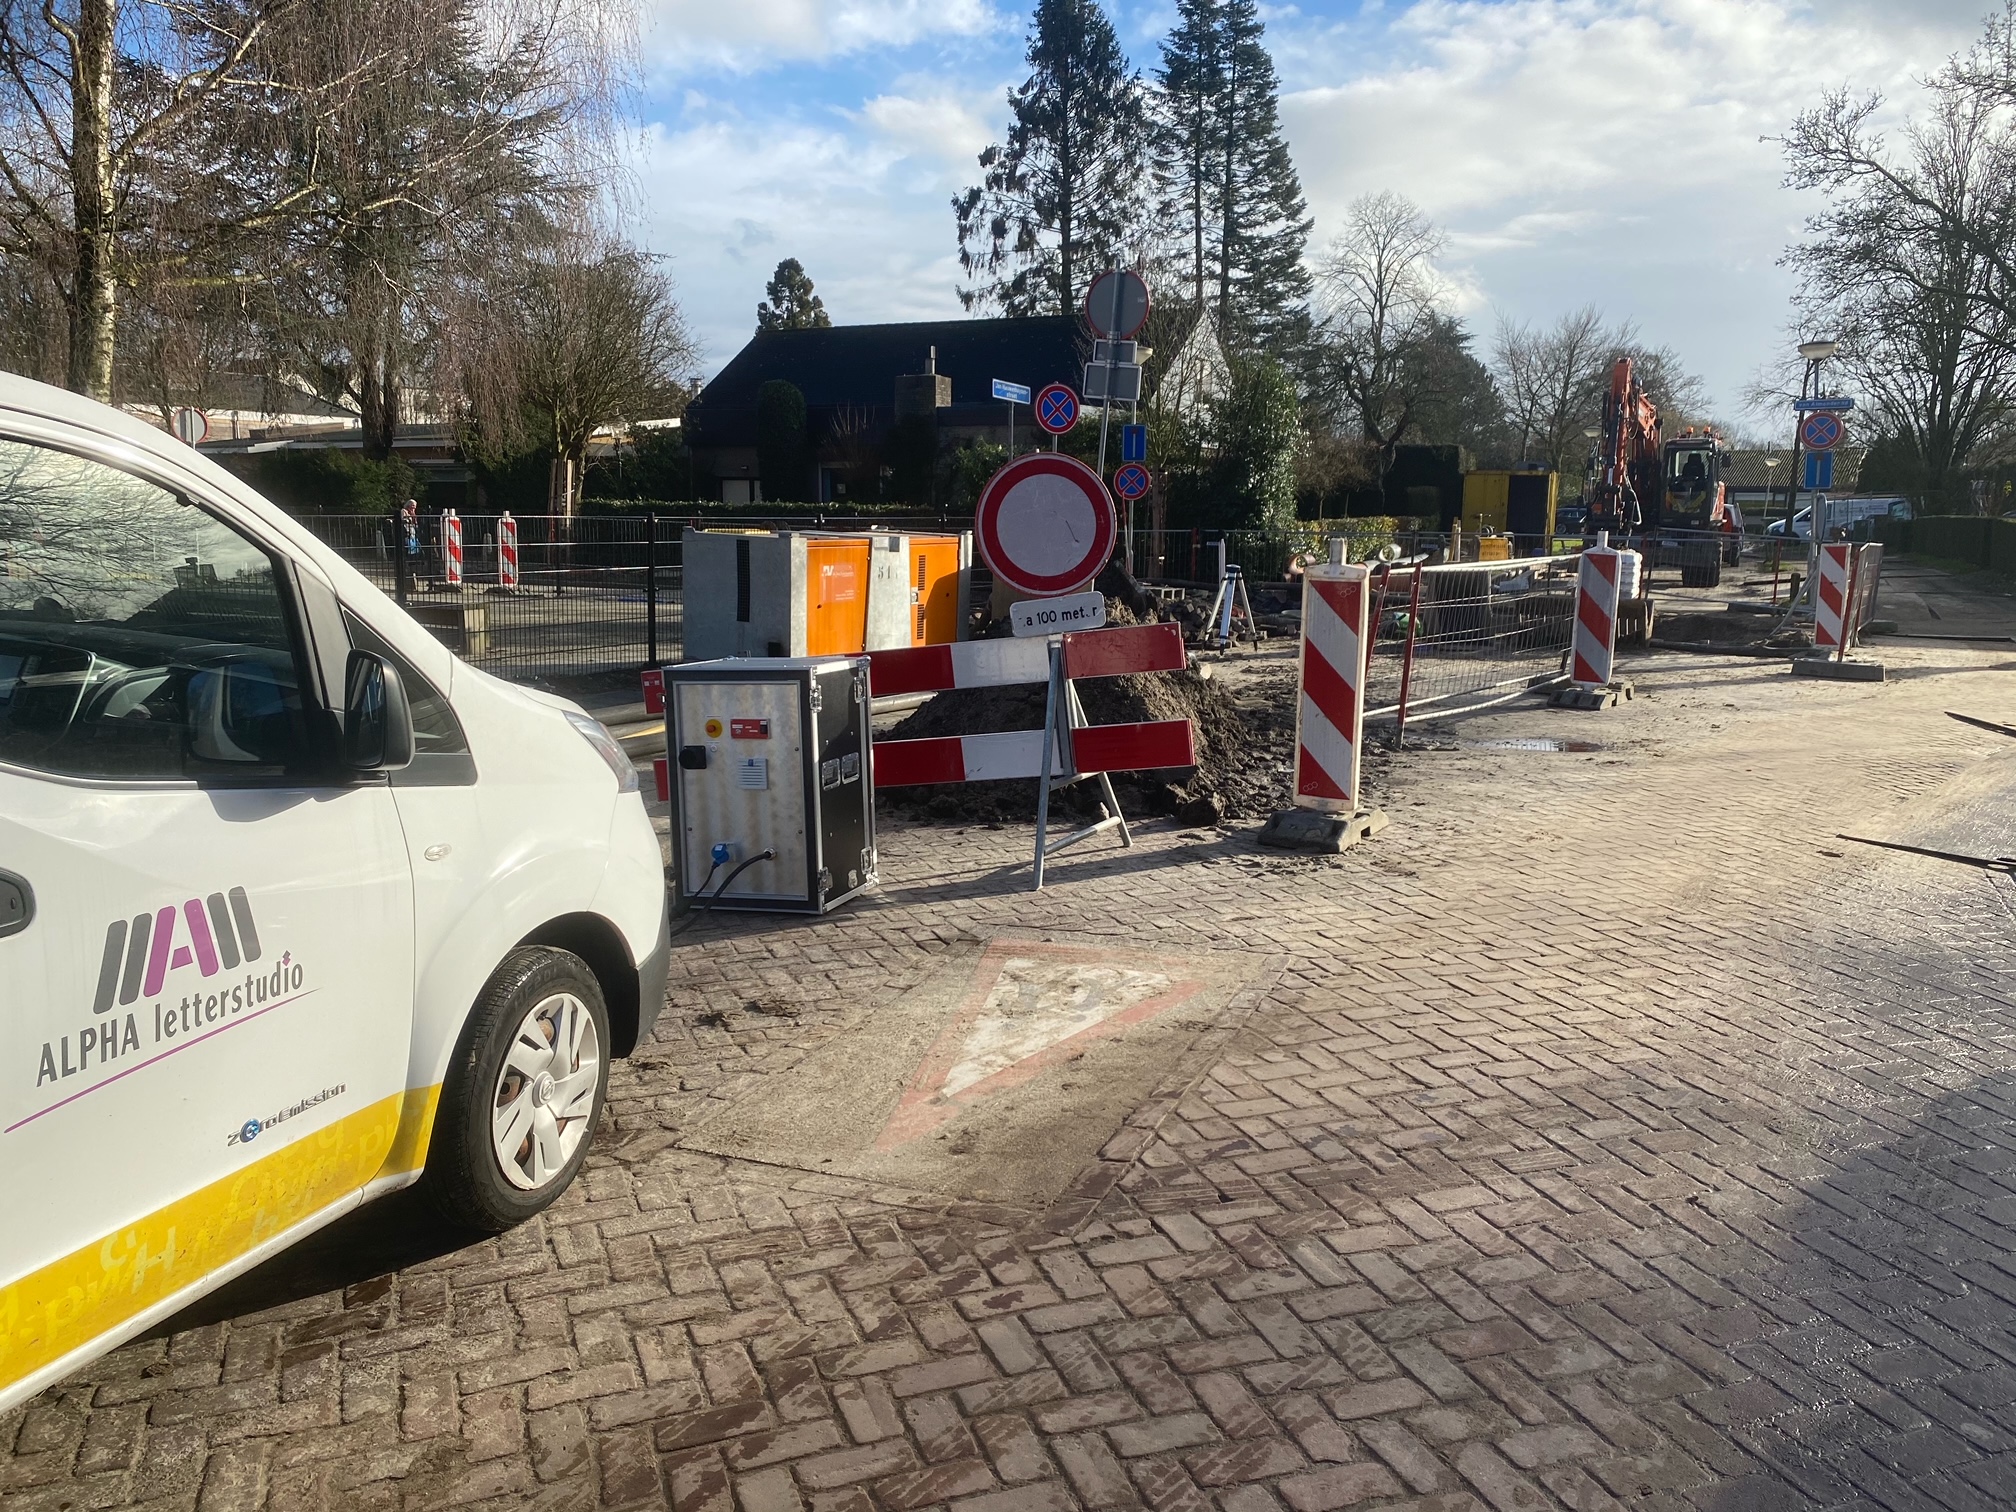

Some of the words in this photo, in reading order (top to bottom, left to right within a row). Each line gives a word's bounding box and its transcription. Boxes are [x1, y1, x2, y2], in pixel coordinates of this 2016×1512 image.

[1036, 610, 1057, 625] 100
[1061, 606, 1098, 622] metr
[36, 1012, 140, 1088] ALPHA
[154, 949, 304, 1043] letterstudio
